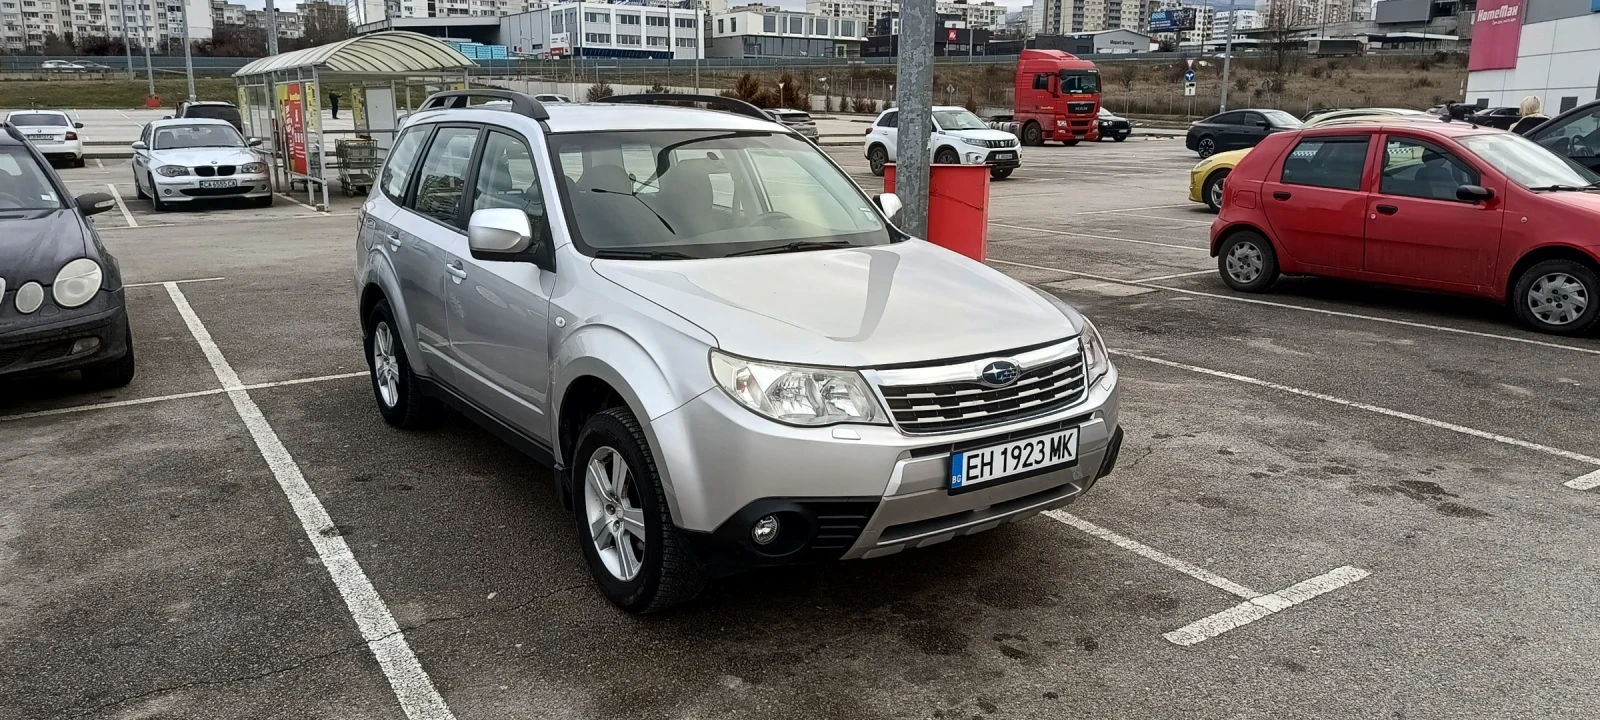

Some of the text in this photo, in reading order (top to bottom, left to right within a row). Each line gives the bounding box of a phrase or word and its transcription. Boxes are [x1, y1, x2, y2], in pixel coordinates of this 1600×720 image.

[1477, 5, 1518, 22] HomeMax
[966, 432, 1074, 481] EH 1923 MK
[952, 475, 961, 484] BG
